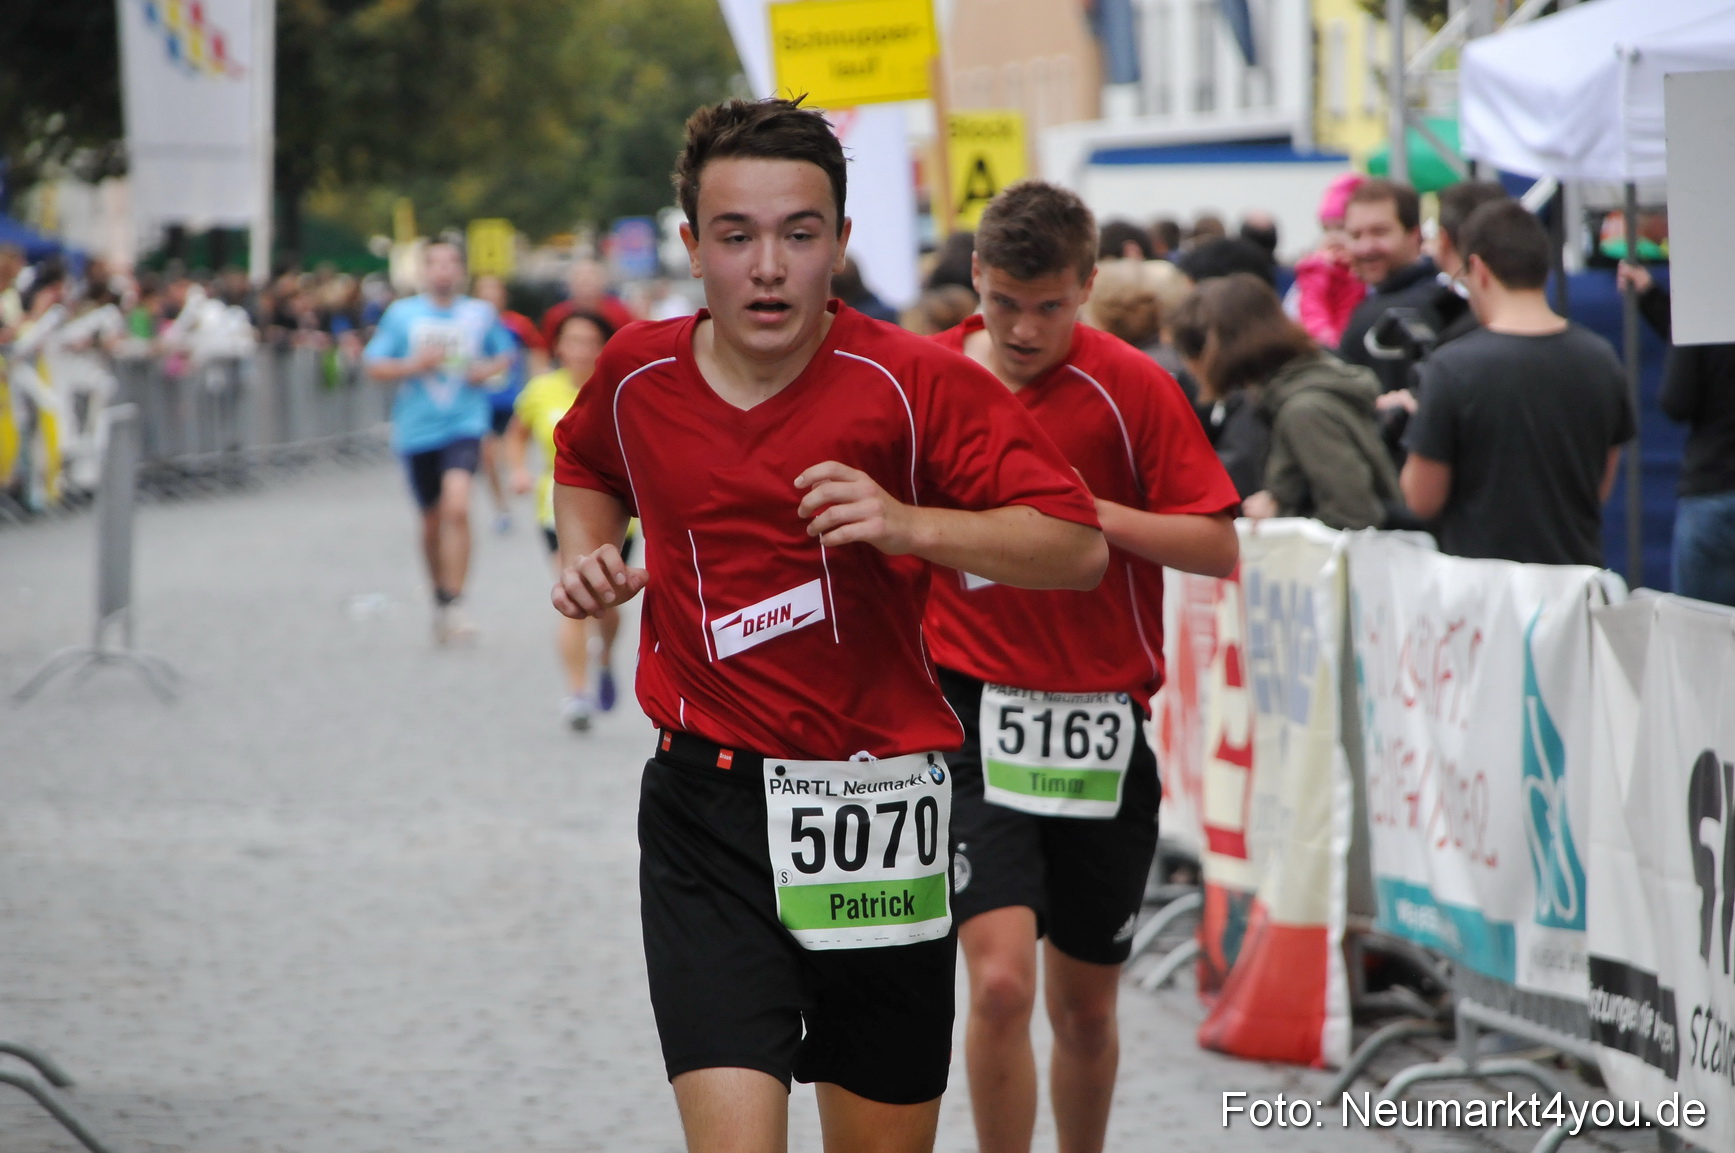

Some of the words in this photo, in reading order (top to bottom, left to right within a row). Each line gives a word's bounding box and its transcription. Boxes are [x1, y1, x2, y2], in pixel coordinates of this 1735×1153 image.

[957, 157, 1000, 215] A
[743, 603, 792, 637] DEHN
[998, 705, 1121, 760] 5163
[769, 779, 838, 796] PARTL
[843, 773, 927, 796] Neumarkt
[790, 795, 938, 874] 5070
[781, 871, 789, 884] S
[829, 889, 916, 921] Patrick
